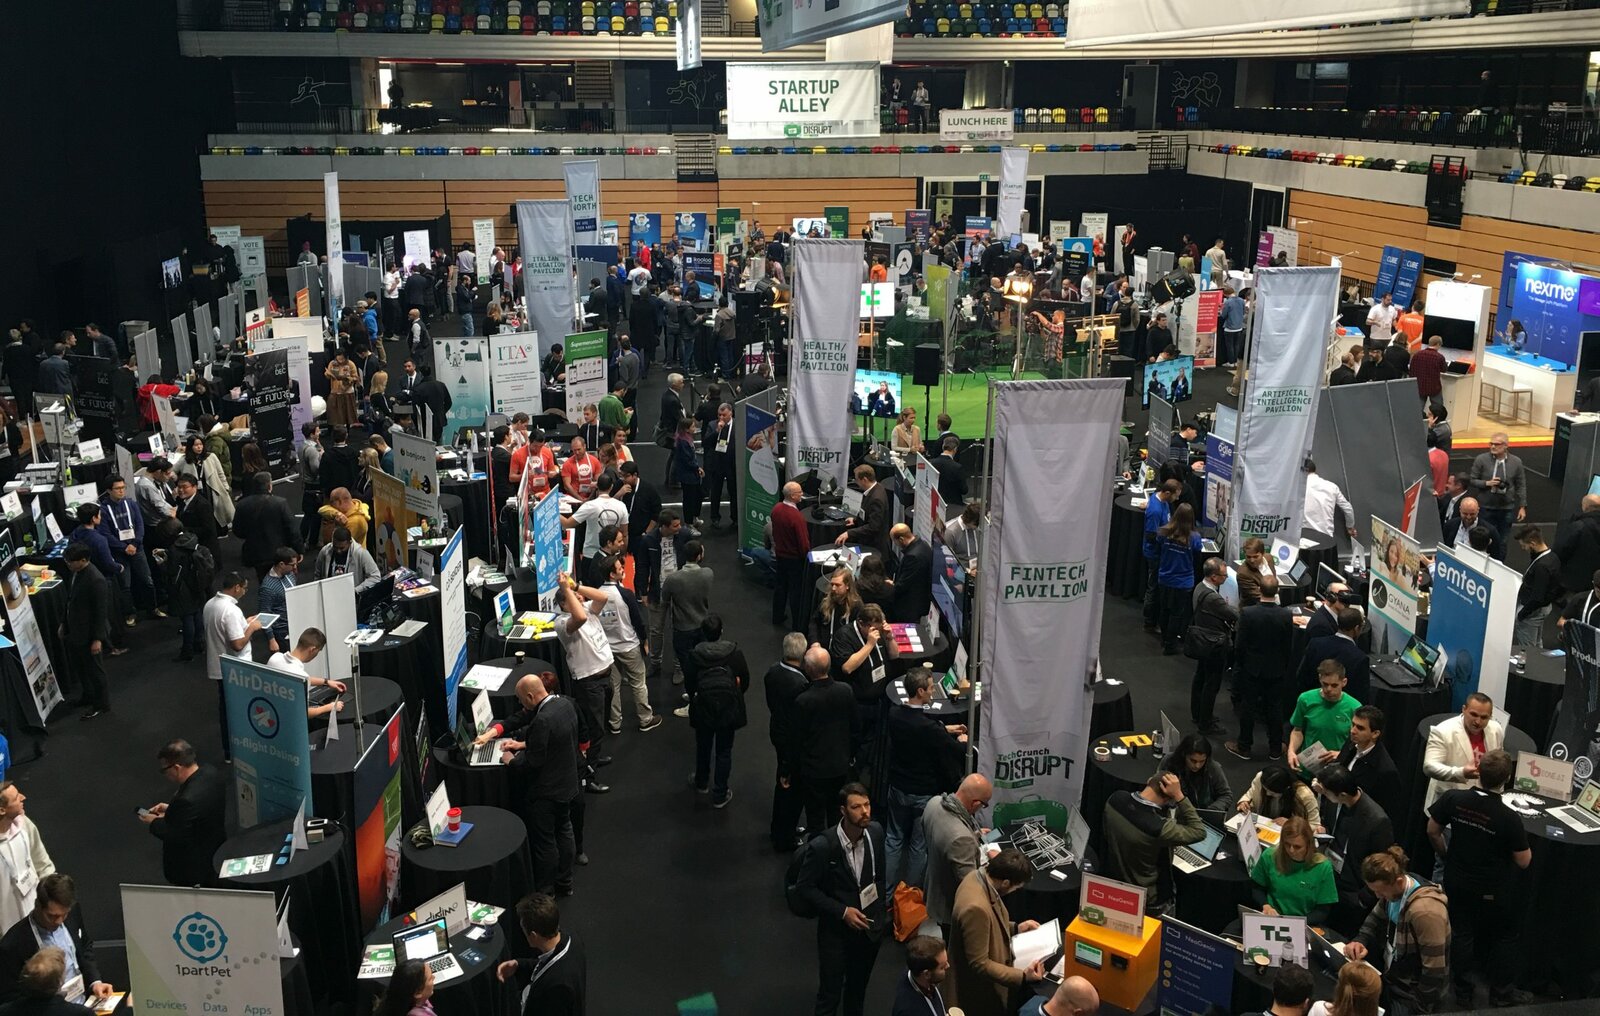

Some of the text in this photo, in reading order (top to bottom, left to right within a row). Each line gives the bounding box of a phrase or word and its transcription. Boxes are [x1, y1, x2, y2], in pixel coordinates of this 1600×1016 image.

[768, 79, 840, 95] STARTUP
[778, 97, 830, 113] ALLEY
[947, 117, 1008, 126] LUNCH HERE
[573, 194, 594, 203] TECH
[1525, 277, 1575, 302] nexmo
[497, 345, 528, 361] ITA
[803, 341, 847, 351] HEALTH/
[803, 351, 847, 362] BIOTECH
[275, 368, 286, 376] DEC
[800, 361, 849, 372] PAVILION
[250, 397, 262, 407] THE
[265, 390, 290, 403] FUTURE
[1257, 397, 1312, 405] INTELLIGENCE
[1261, 389, 1309, 398] ARTIFICIAL
[1265, 405, 1302, 413] PAVILION
[797, 450, 842, 464] DISRUPT
[1240, 517, 1291, 533] DISRUPT
[1010, 564, 1086, 581] FINTECH
[1004, 579, 1088, 599] PAVILION
[1437, 561, 1488, 609] emteq
[1388, 594, 1411, 616] GYANA
[228, 667, 296, 701] AirDates
[269, 744, 300, 767] Dating
[997, 747, 1050, 761] TechCrunch
[994, 756, 1075, 781] DISRUPT
[1260, 924, 1290, 942] TC
[223, 955, 229, 964] 1
[175, 964, 232, 978] 1partPet
[146, 999, 272, 1016] Devices Data Apps
